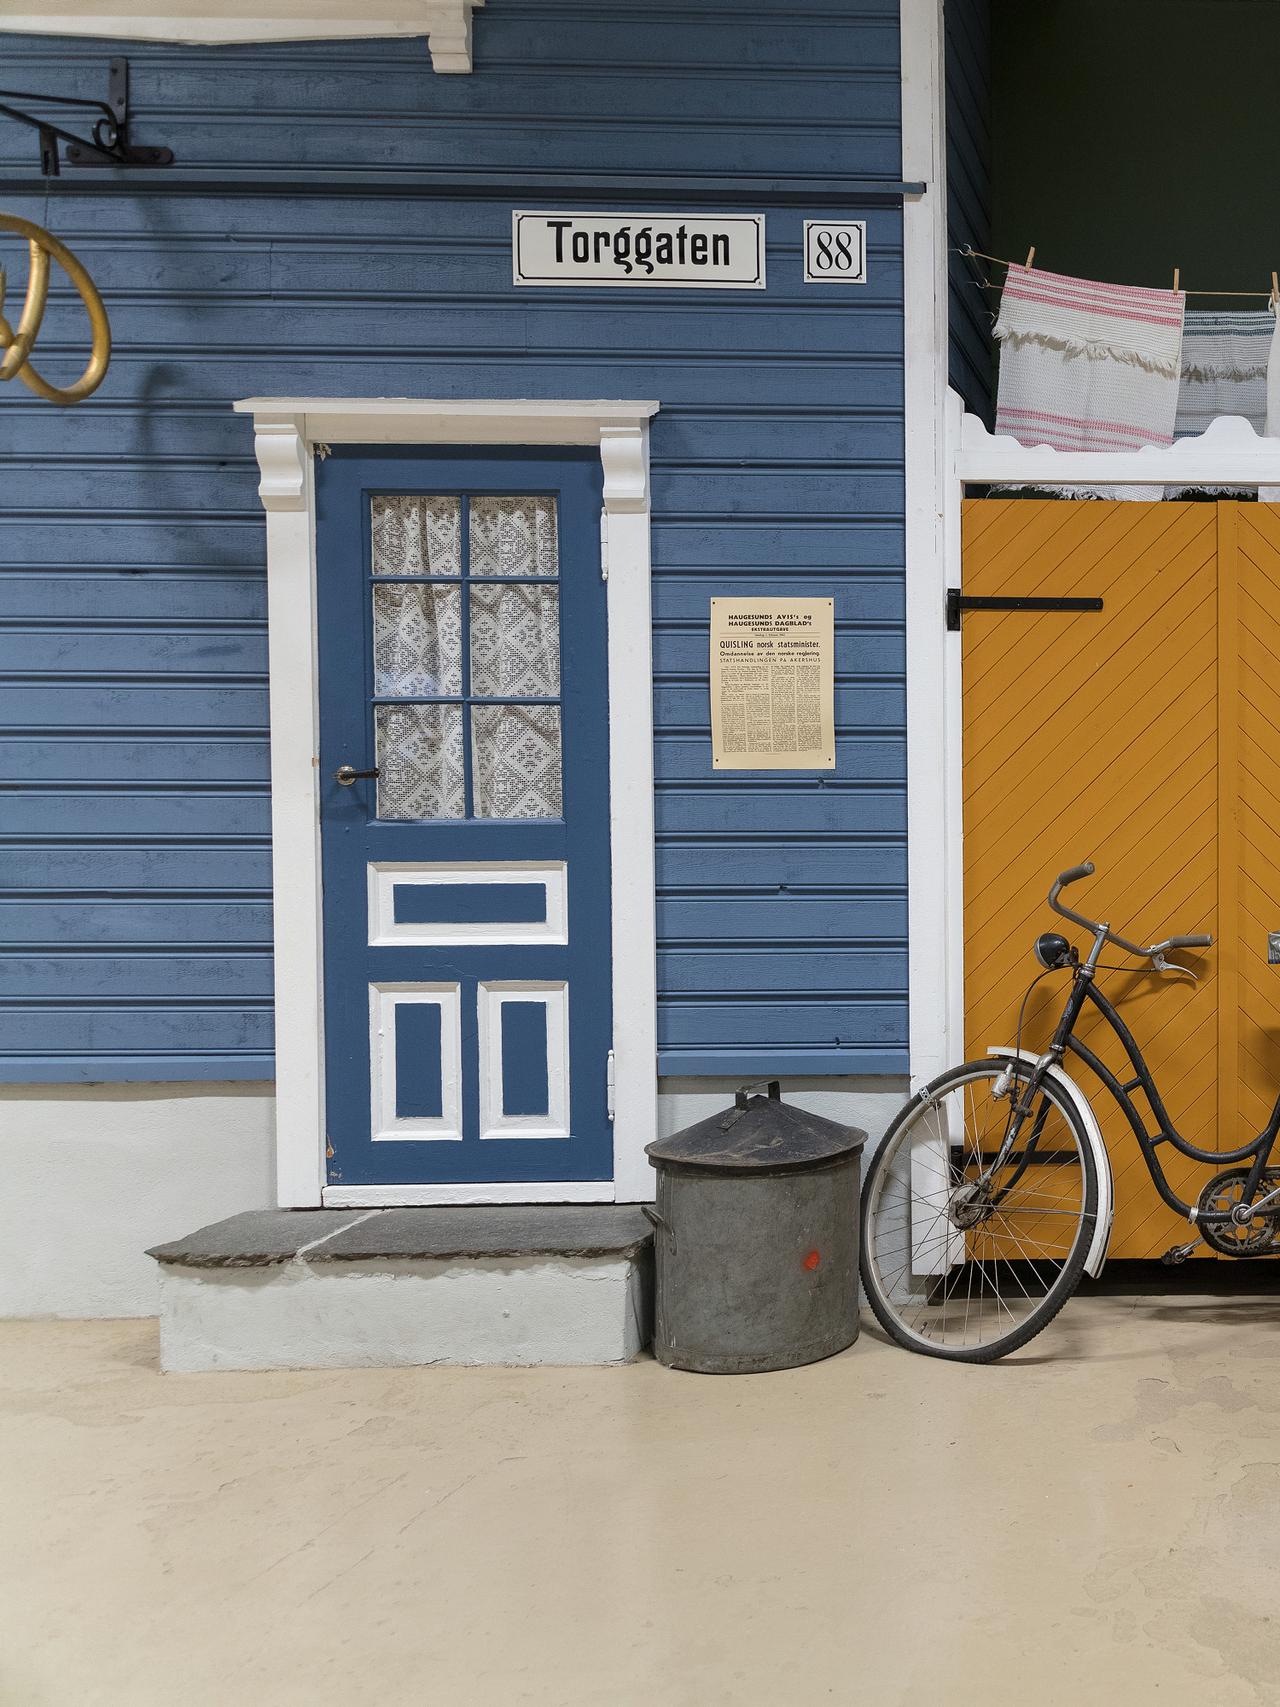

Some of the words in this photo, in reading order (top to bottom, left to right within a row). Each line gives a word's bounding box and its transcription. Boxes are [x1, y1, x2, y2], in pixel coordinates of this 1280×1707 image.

[547, 220, 730, 275] Torggaten
[816, 231, 852, 271] 88
[720, 640, 754, 649] QUISLING
[756, 640, 774, 648] norsk
